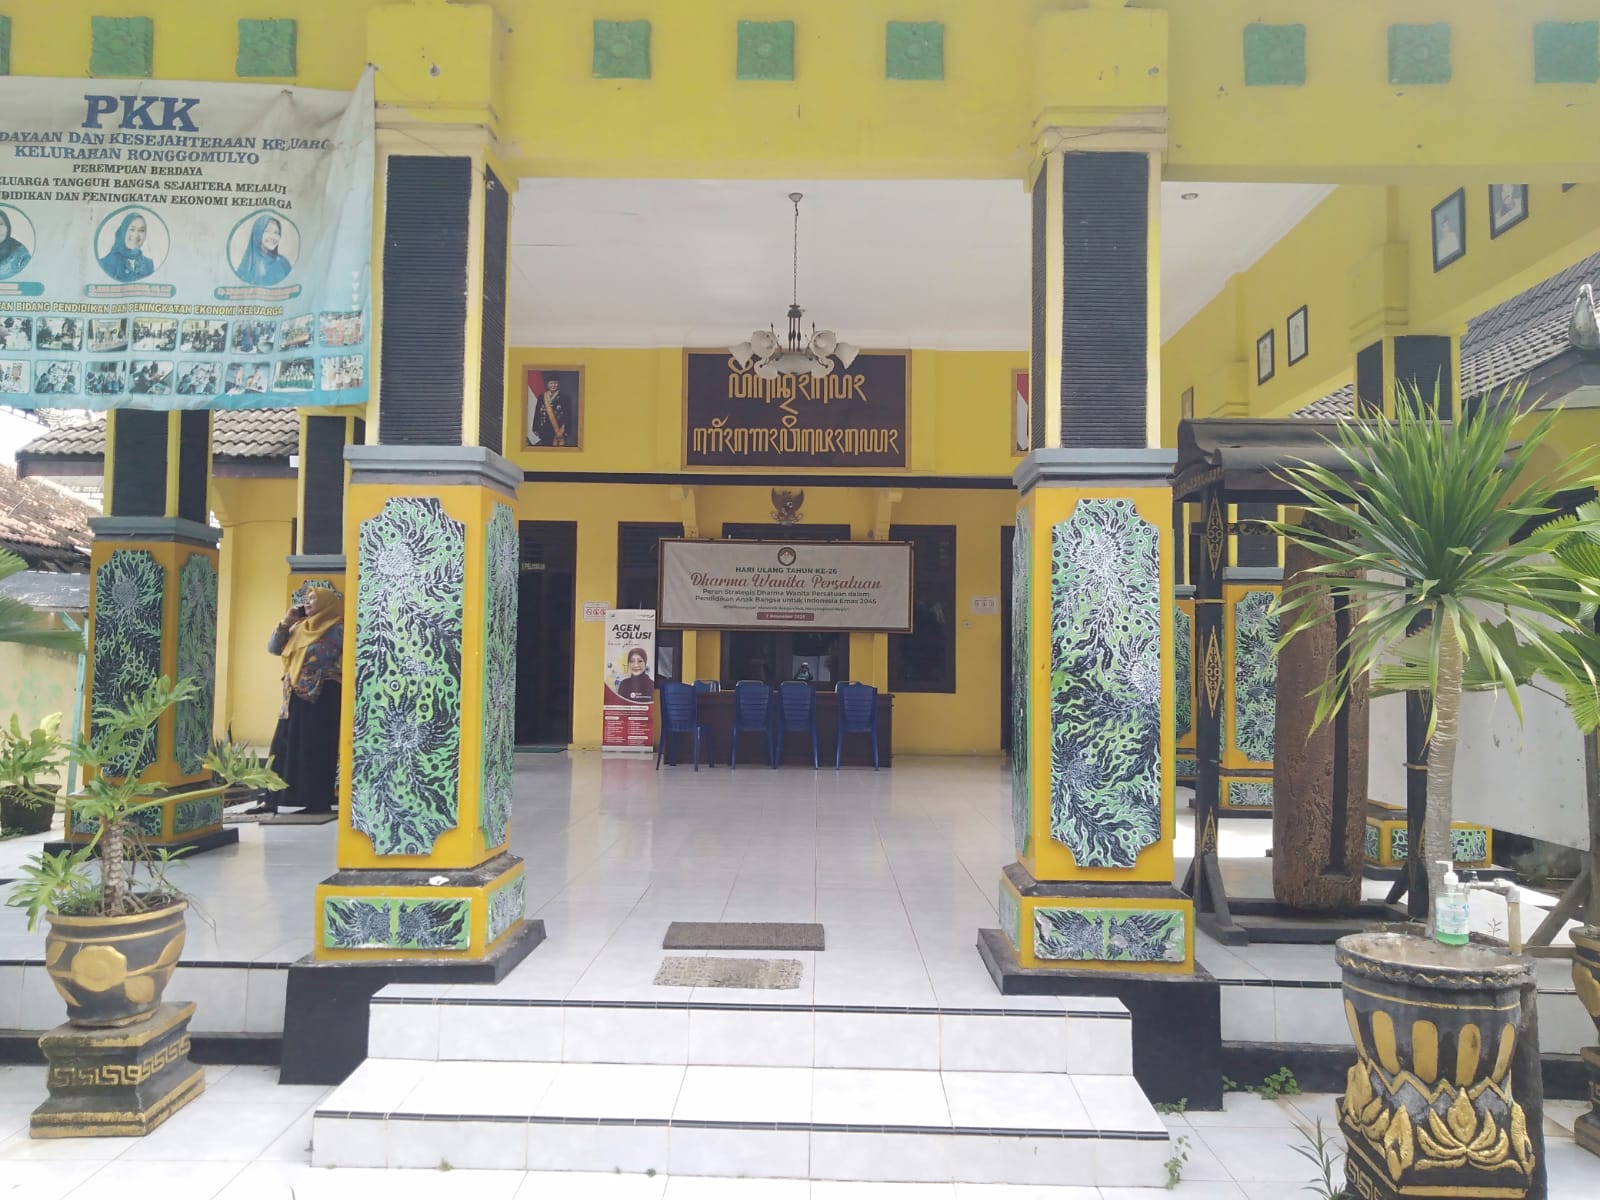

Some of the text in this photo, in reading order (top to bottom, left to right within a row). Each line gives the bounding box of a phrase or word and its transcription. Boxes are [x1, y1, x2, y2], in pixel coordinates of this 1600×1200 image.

[81, 94, 200, 132] PKK
[68, 132, 105, 145] DAN
[109, 133, 256, 149] KESEJAHTERAAN
[14, 145, 260, 165] KELURAHAN RONGGOMULYO
[72, 163, 203, 176] PEREMPUAN BERDAYA
[0, 176, 287, 196] LUARGA TANGGUH BANGSA SEJAHTERA MELALUI
[0, 190, 293, 210] DIDIKAN DAN PENINGKATAN EKONOMI KELUARGA
[16, 301, 50, 312] BIDANG
[52, 302, 109, 314] PENDIDIKAN
[128, 303, 192, 315] PENINGKATAN
[691, 572, 748, 588] Dharma
[752, 573, 805, 588] Wanita
[724, 588, 756, 597] Strategis
[612, 623, 640, 632] AGEN
[615, 631, 652, 640] SOLUSI
